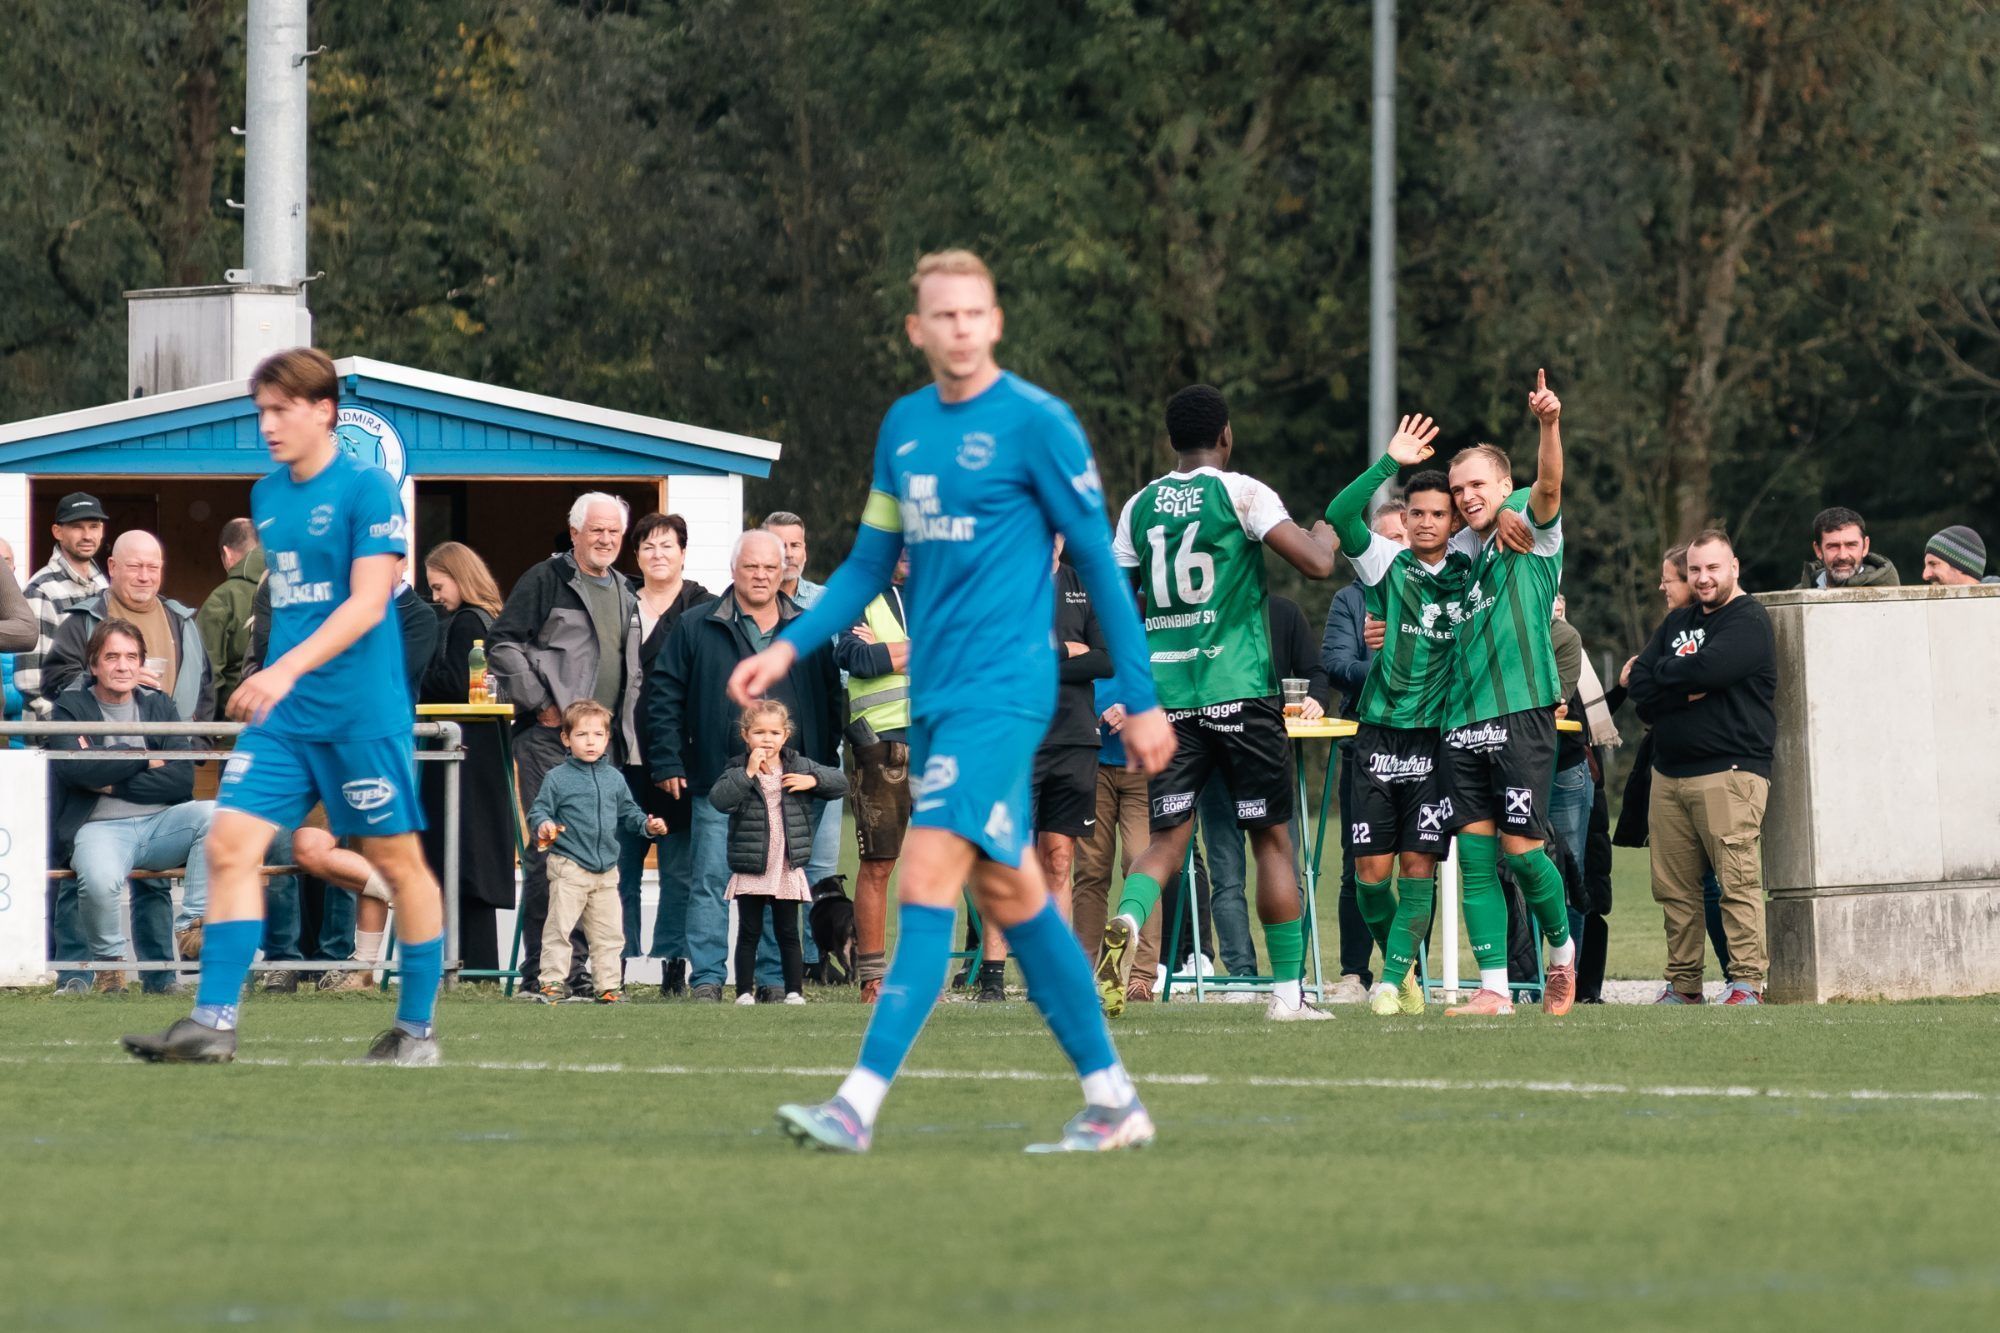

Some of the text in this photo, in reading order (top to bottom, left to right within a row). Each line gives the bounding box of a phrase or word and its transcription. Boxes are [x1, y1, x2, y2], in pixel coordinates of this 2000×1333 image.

[1146, 520, 1215, 608] 16
[1406, 564, 1426, 577] JAKO
[1238, 806, 1264, 817] ORGA
[1440, 796, 1454, 821] 23
[1507, 816, 1527, 825] JAKO
[1352, 822, 1372, 844] 22
[1419, 833, 1439, 842] JAKO
